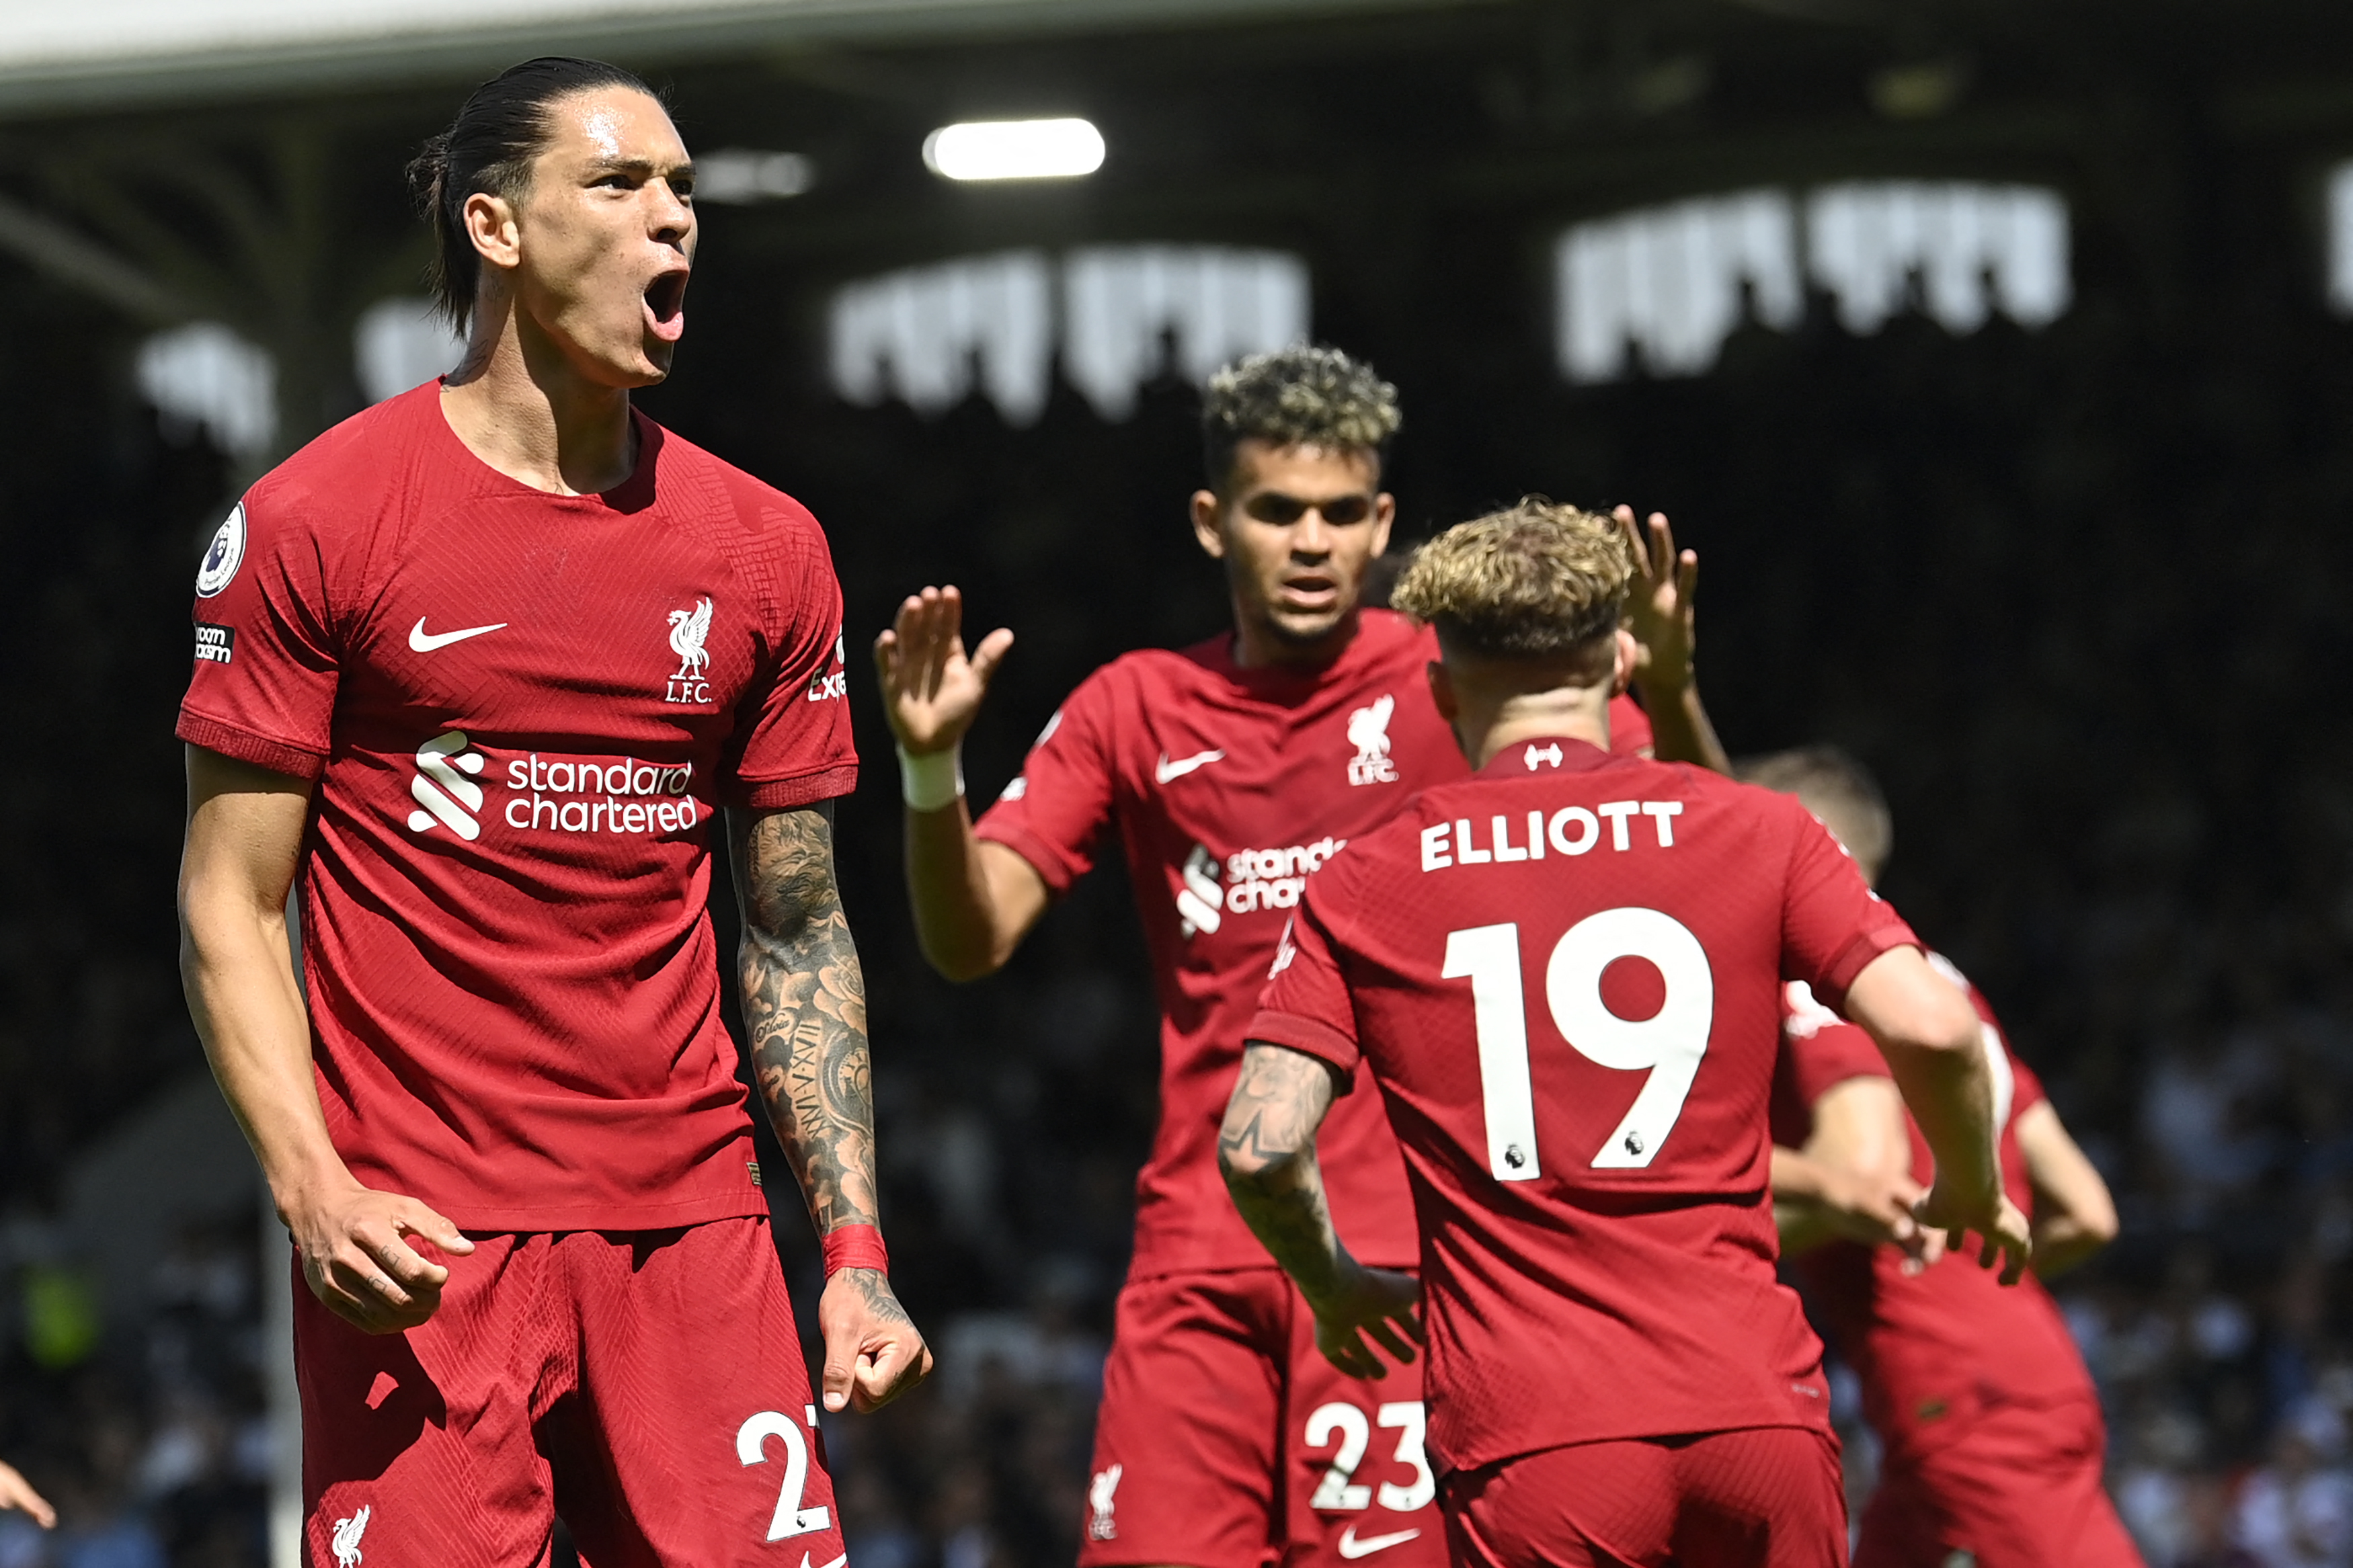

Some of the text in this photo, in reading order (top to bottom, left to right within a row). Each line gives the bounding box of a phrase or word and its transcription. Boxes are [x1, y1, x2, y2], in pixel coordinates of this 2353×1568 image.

[665, 680, 713, 704] L.F.C.
[506, 752, 693, 796] standard
[505, 792, 696, 835] chartered
[1421, 800, 1683, 872] ELLIOTT
[1441, 906, 1714, 1182] 19
[735, 1404, 832, 1542] 2
[1304, 1401, 1436, 1512] 23
